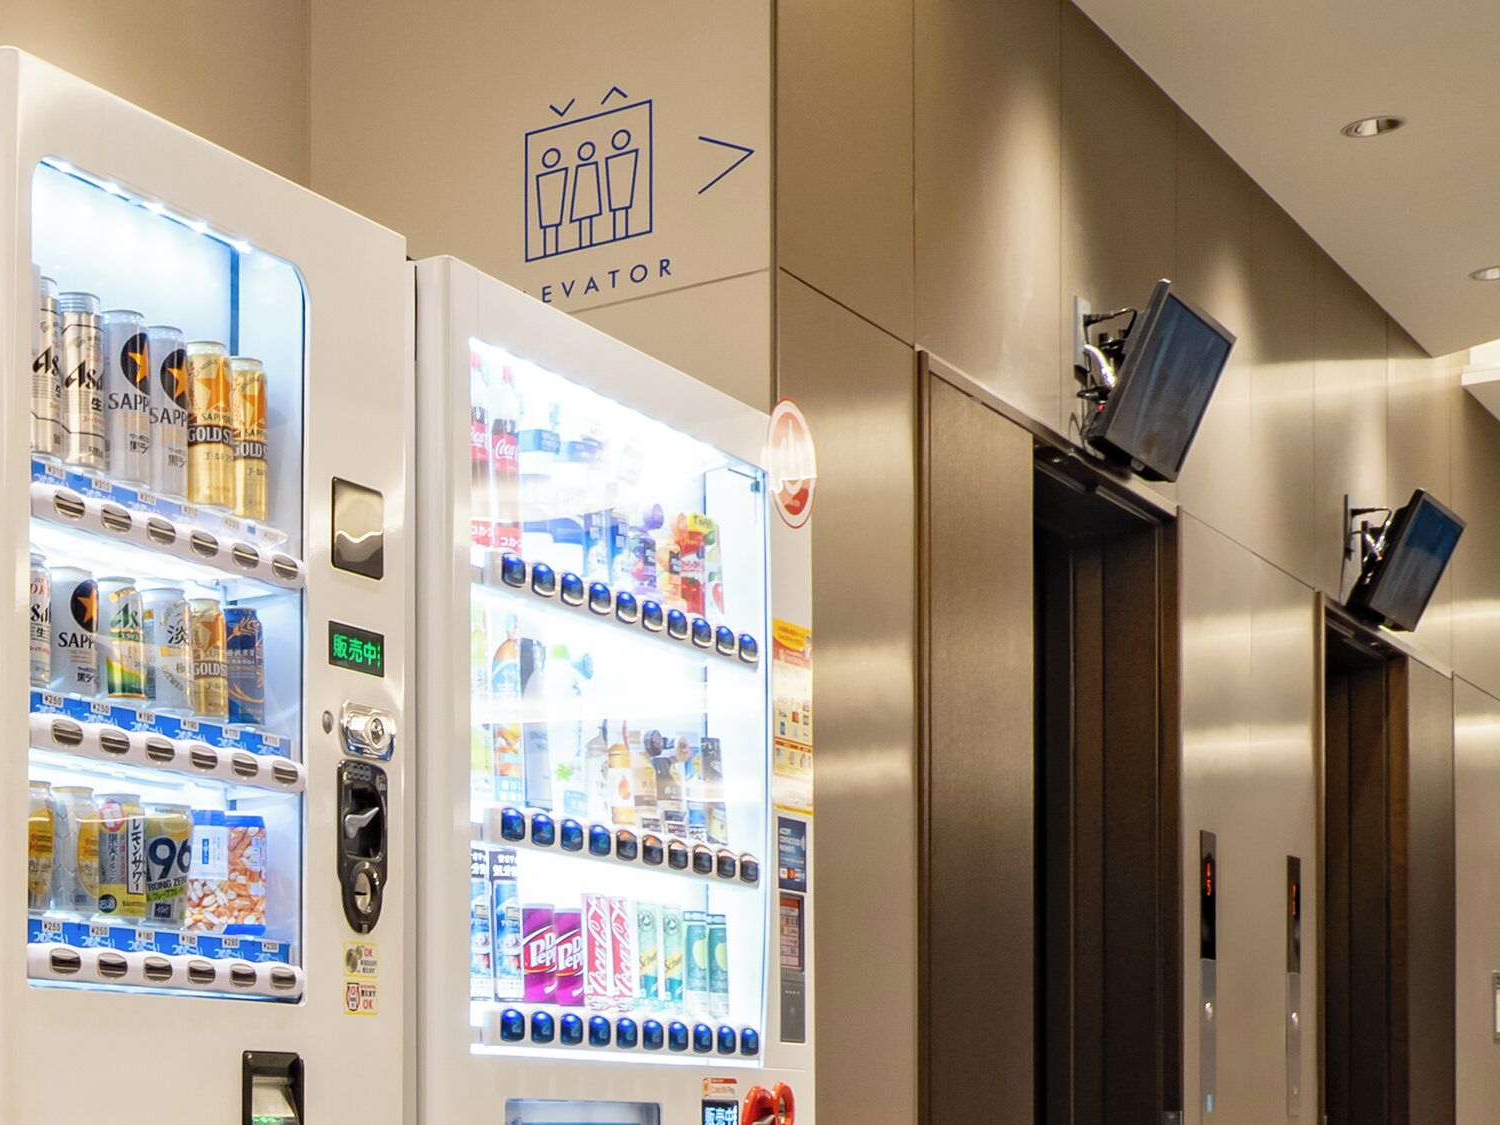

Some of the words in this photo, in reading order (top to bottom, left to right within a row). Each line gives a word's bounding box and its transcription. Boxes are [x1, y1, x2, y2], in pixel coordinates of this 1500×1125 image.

[541, 258, 671, 303] EVATOR
[188, 426, 221, 443] GOLD
[167, 624, 190, 645] 淡
[332, 633, 381, 667] 販売中
[194, 661, 220, 677] GOLD
[44, 694, 62, 706] ¥250
[92, 703, 110, 714] ¥250
[130, 818, 143, 892] レモンサワー
[43, 921, 61, 932] ¥250
[91, 926, 108, 936] ¥250
[364, 948, 373, 957] OK
[363, 999, 373, 1010] OK
